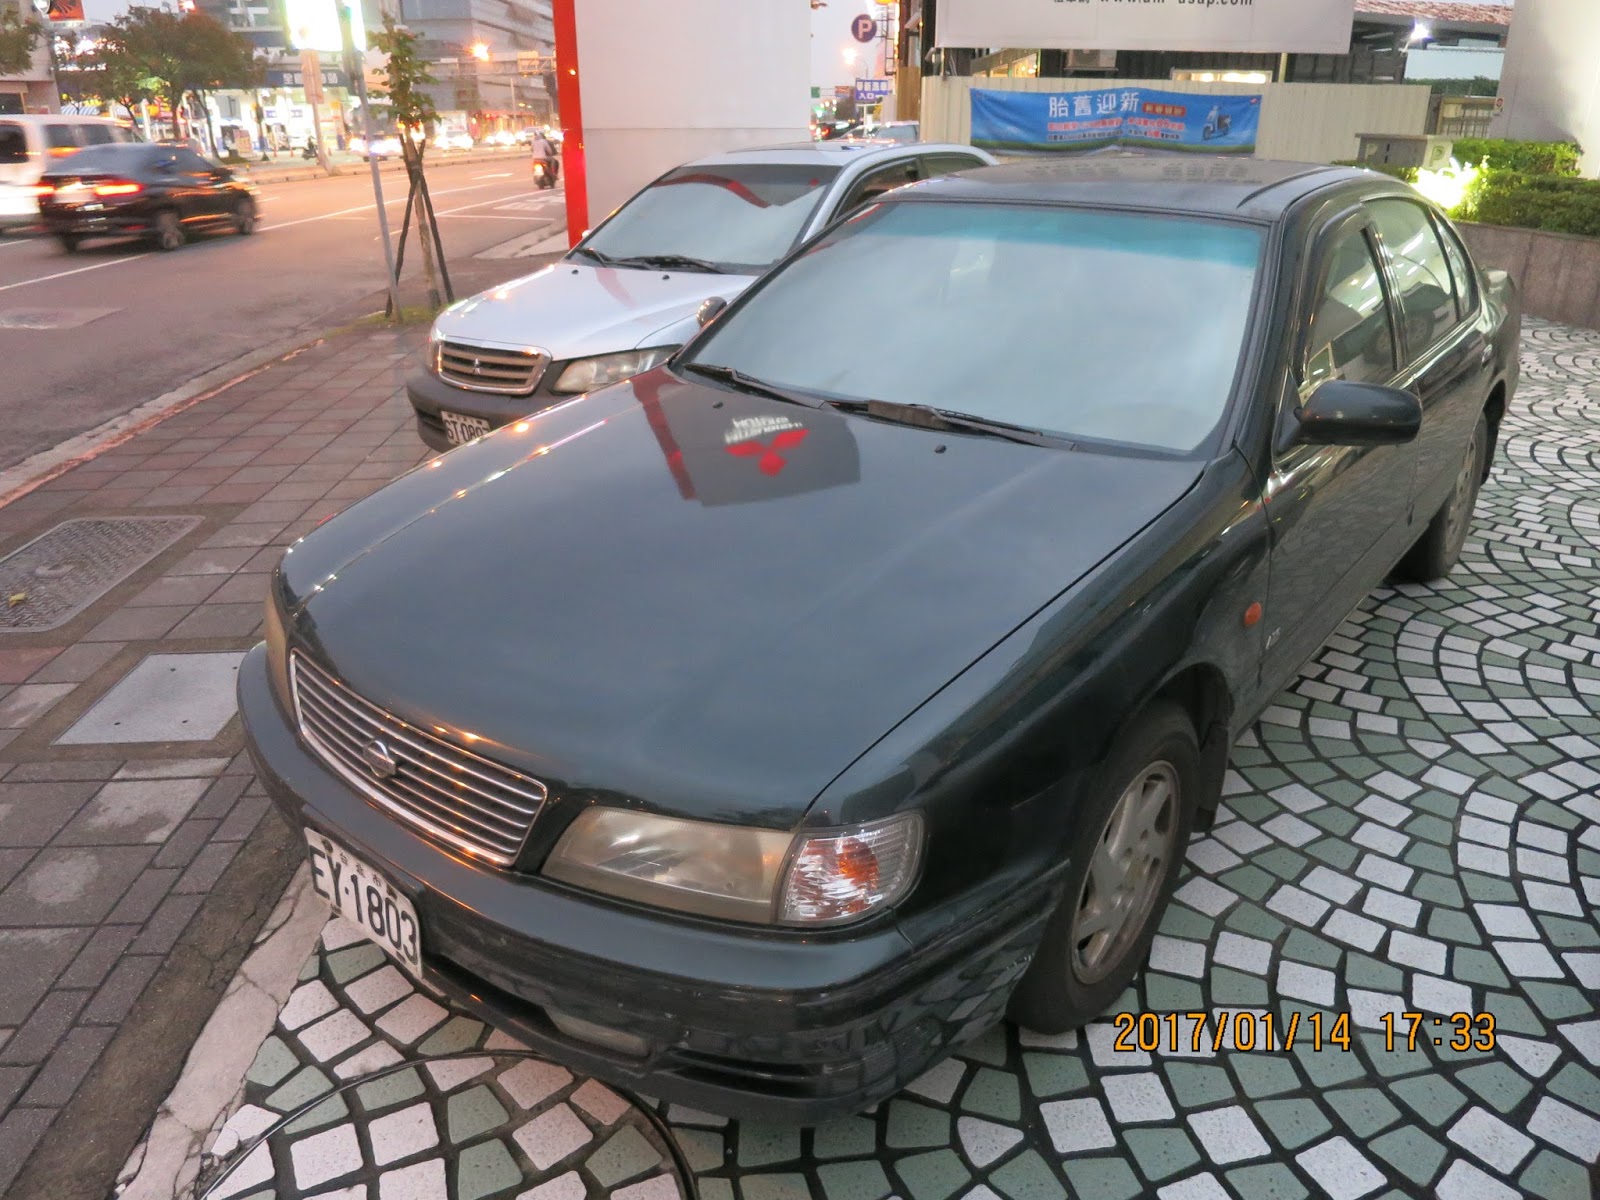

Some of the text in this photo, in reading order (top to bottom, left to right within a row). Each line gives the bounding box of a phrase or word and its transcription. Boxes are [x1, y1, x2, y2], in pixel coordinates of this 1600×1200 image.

[858, 19, 873, 39] P
[1048, 91, 1140, 118] 胎舊迎新
